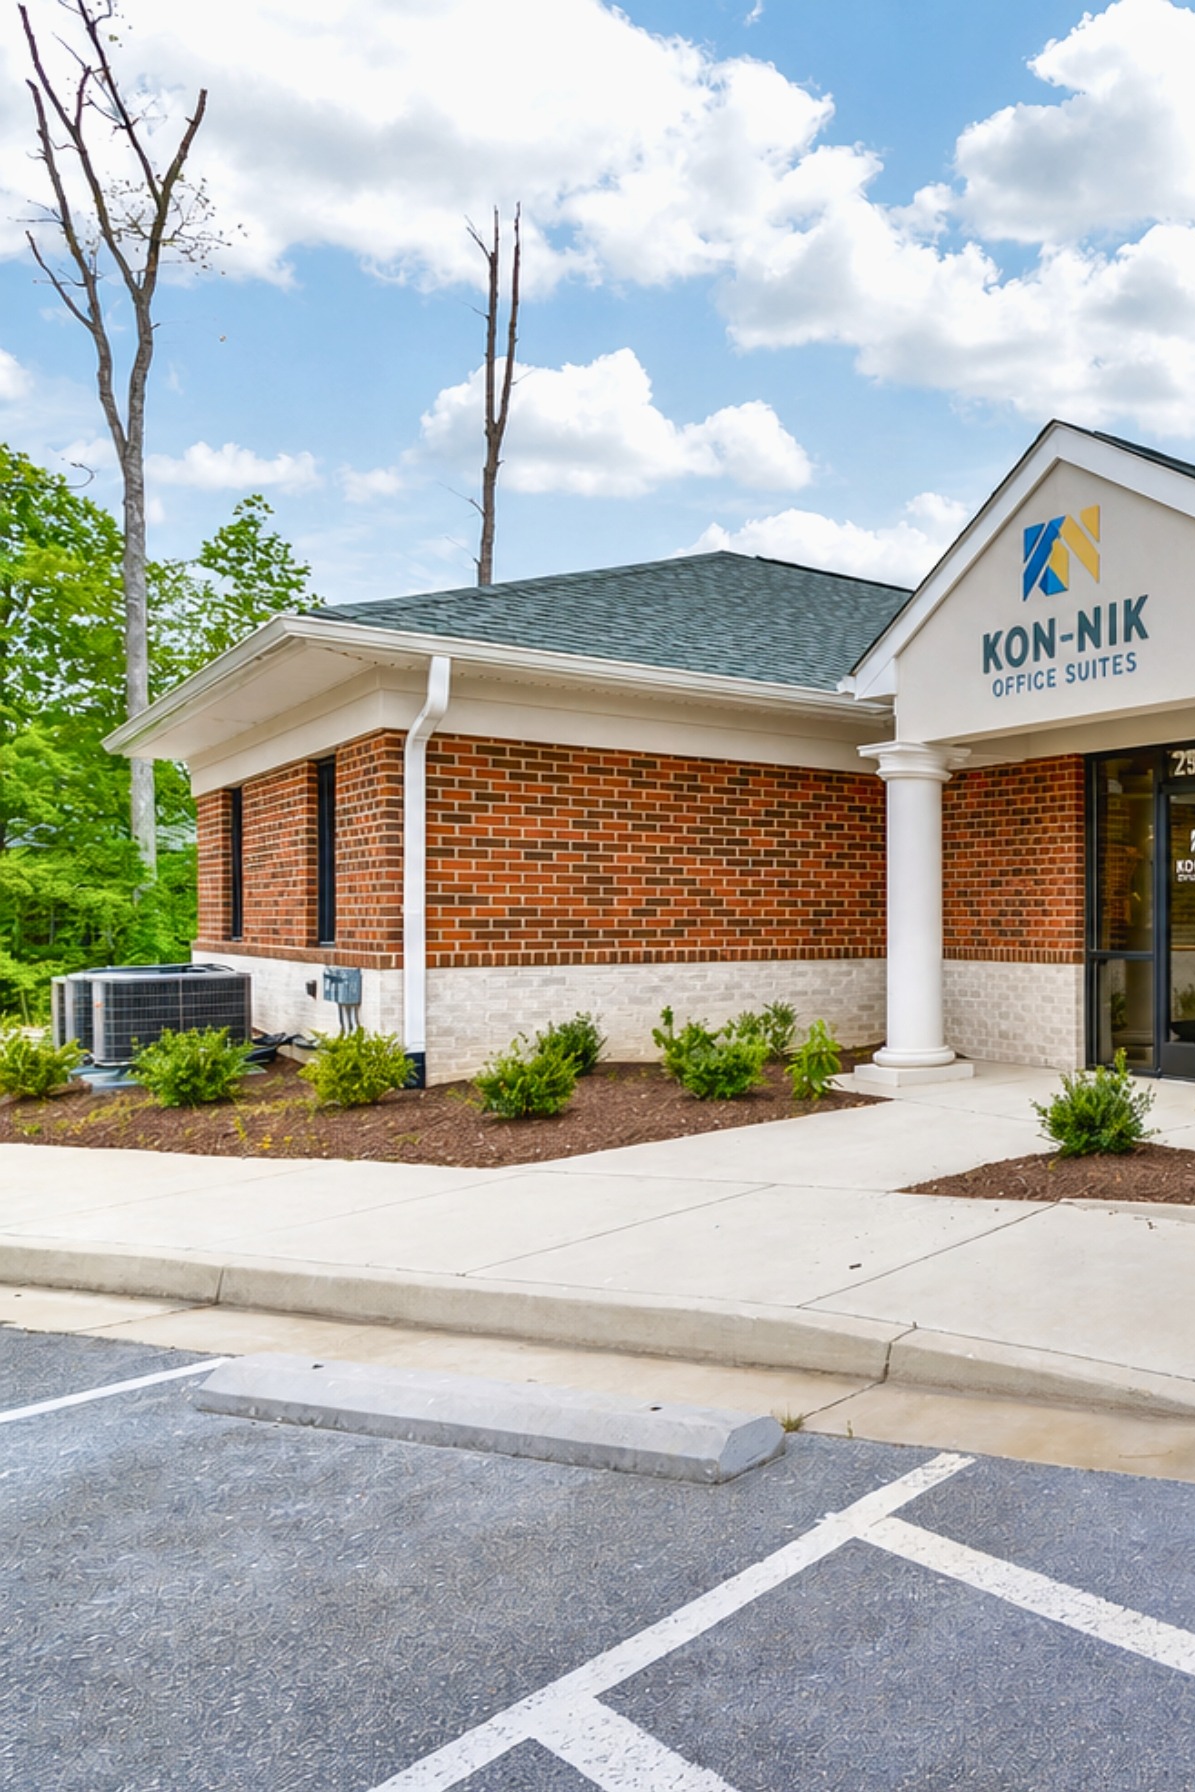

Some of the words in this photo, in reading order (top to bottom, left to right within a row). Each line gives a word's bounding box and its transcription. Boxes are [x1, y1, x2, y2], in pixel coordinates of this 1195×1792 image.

[982, 594, 1149, 675] KON-NIK
[992, 668, 1057, 698] OFFICE
[1065, 652, 1137, 684] SUITES
